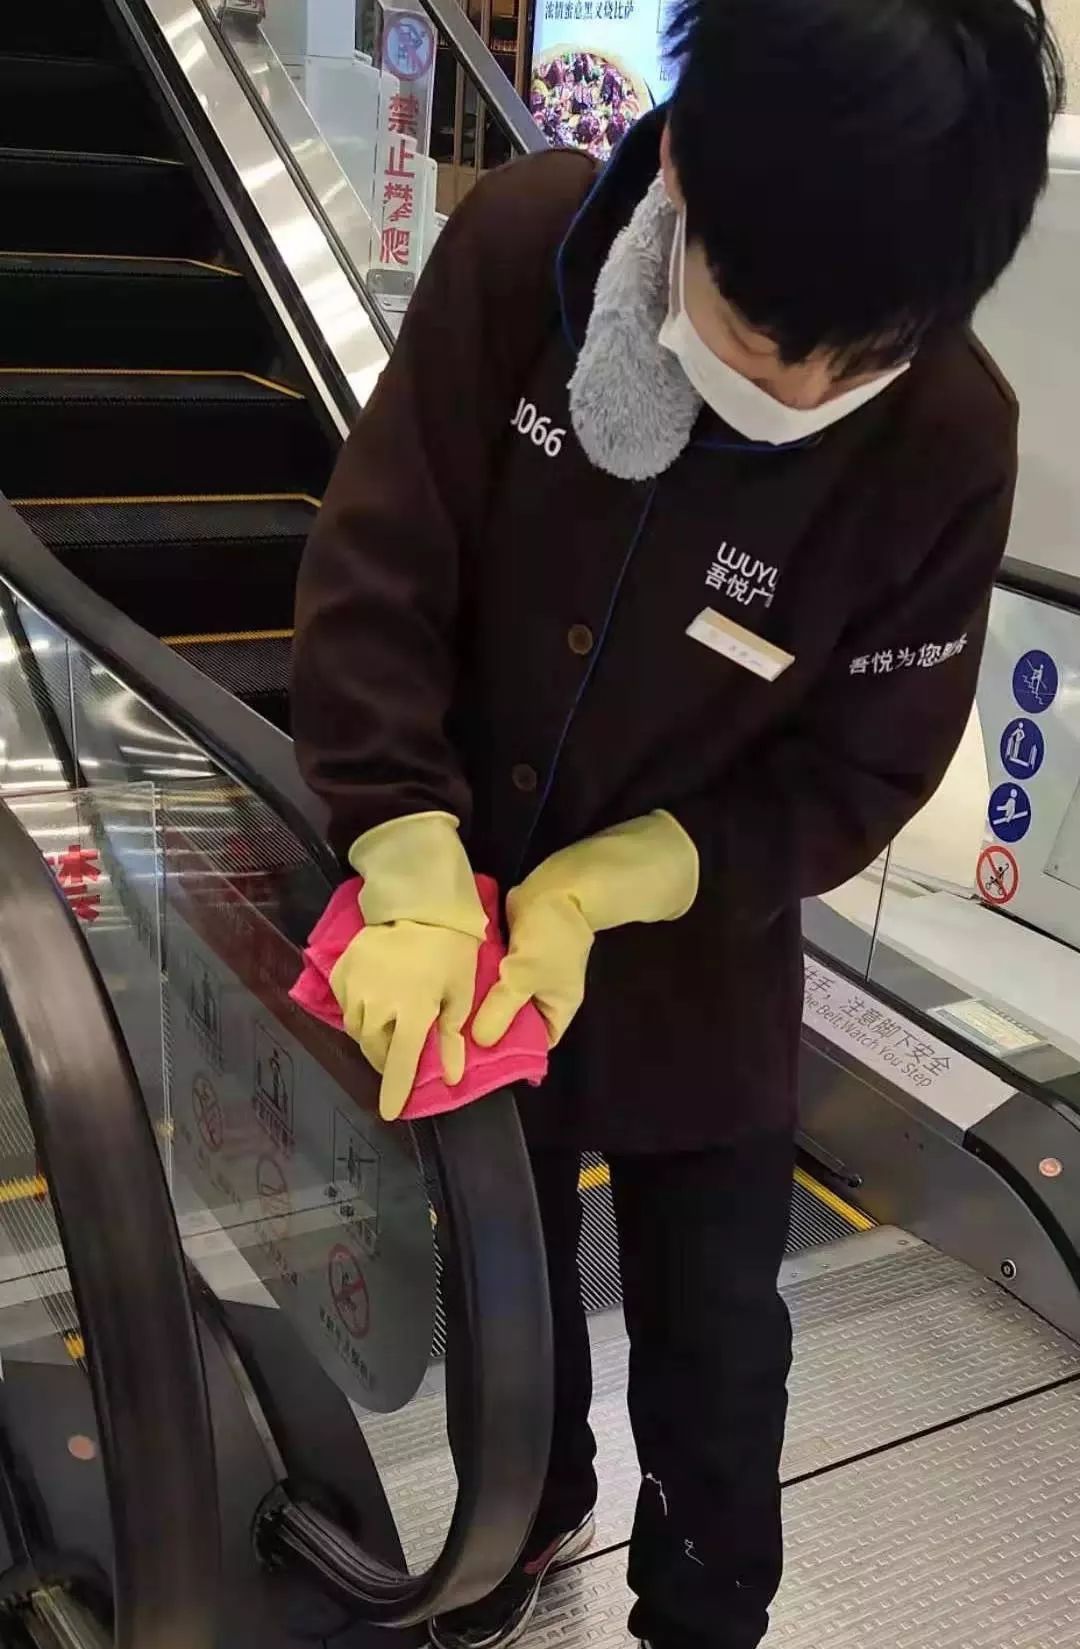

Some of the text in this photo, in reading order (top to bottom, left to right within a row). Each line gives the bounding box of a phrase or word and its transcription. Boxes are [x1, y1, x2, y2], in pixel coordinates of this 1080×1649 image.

[380, 93, 419, 265] 禁止攀爬
[705, 562, 775, 609] 吾悦广
[879, 1044, 902, 1067] You
[901, 1062, 932, 1088] Step
